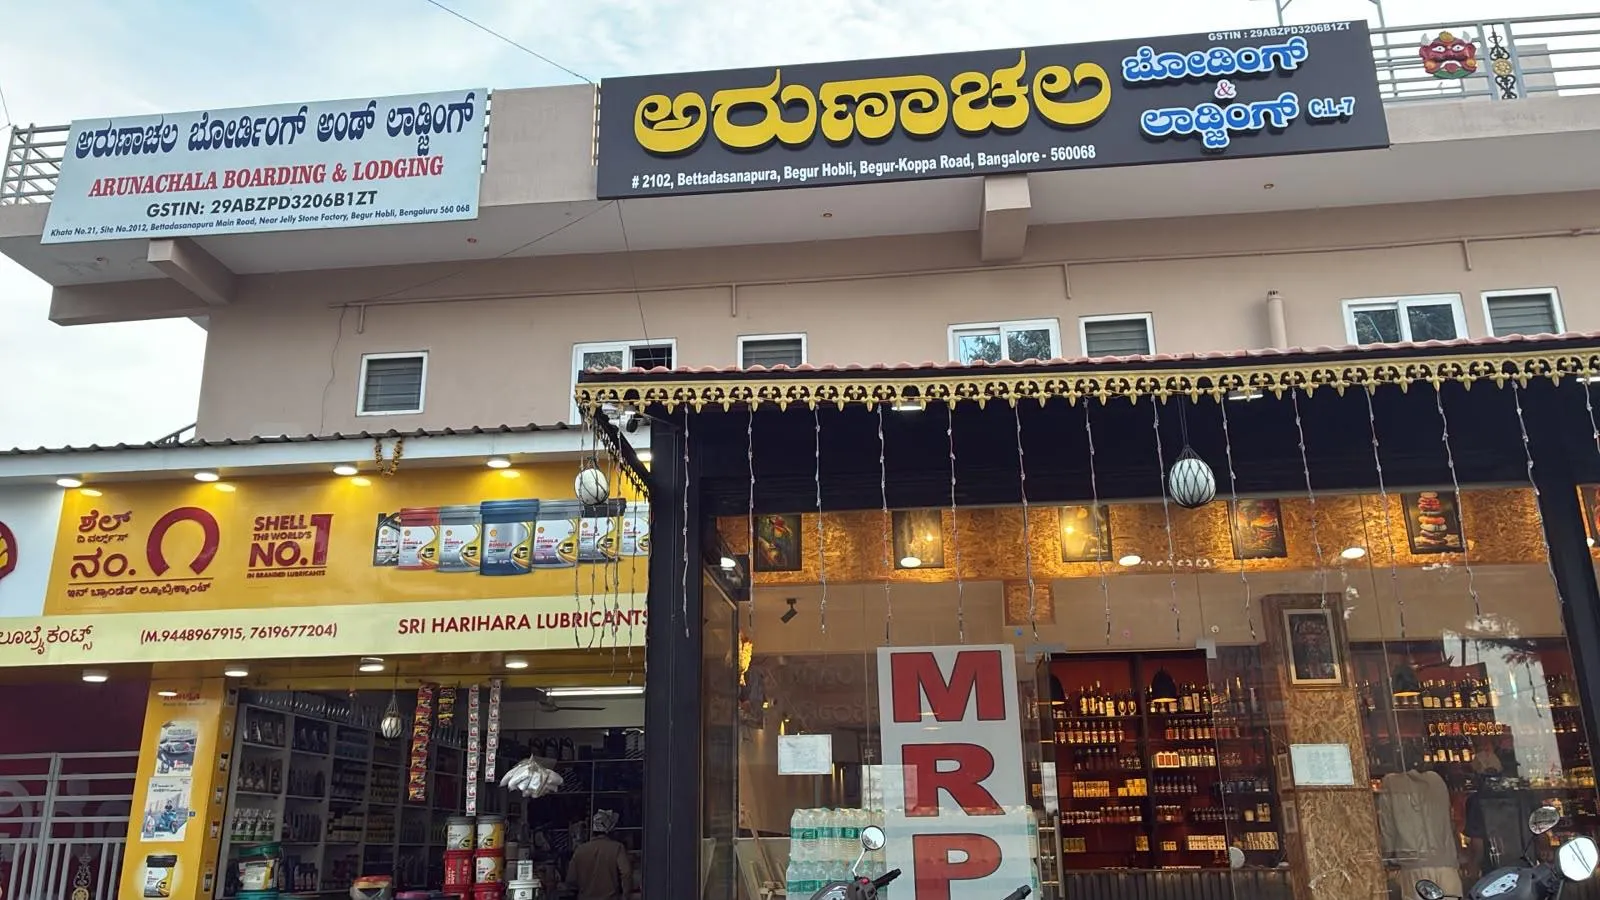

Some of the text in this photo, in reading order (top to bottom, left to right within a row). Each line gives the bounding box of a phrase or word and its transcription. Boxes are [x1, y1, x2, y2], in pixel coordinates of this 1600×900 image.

[1208, 30, 1242, 42] GSTIN
[1250, 21, 1351, 39] 29ABZPD3206B1ZT
[1215, 79, 1236, 98] &
[633, 50, 1112, 154] ಅರುಣಾಚಲ
[75, 92, 475, 159] ಅರುಣಾಚಲ ಬೋರ್ಡಿಂಗ್ ಅಂಡ್ ಲಾಡ್ಜಿಂಗ್
[1141, 92, 1299, 149] ಲಾಡ್ಜಿಂಗ್
[88, 156, 443, 197] ARUNACHALA BOARDING & LODGING
[631, 175, 640, 189] #
[642, 173, 674, 189] 2102,
[677, 167, 781, 187] Bettadasanapura,
[783, 164, 819, 181] Begur
[822, 160, 857, 178] Hobli,
[859, 157, 937, 176] Begur-Koppa
[940, 154, 975, 170] Road,
[977, 150, 1040, 168] Bangalore
[1050, 144, 1096, 162] 560068
[146, 190, 378, 218] GSTIN: 29ABZPD3206B1ZT
[51, 203, 470, 237] Khata No.21, Site No.2012, Bettadasanapura Main Road, Near Jelly Stone Factory, Begur Hobli, Bengaluru 560 068
[78, 509, 132, 533] ಶೆಲ್
[254, 514, 308, 531] SHELL
[253, 531, 312, 541] THE WORLD'S
[140, 623, 337, 644] (M.9448967915, 7619677204)
[398, 617, 425, 634] SRI
[431, 613, 531, 633] HARIHARA
